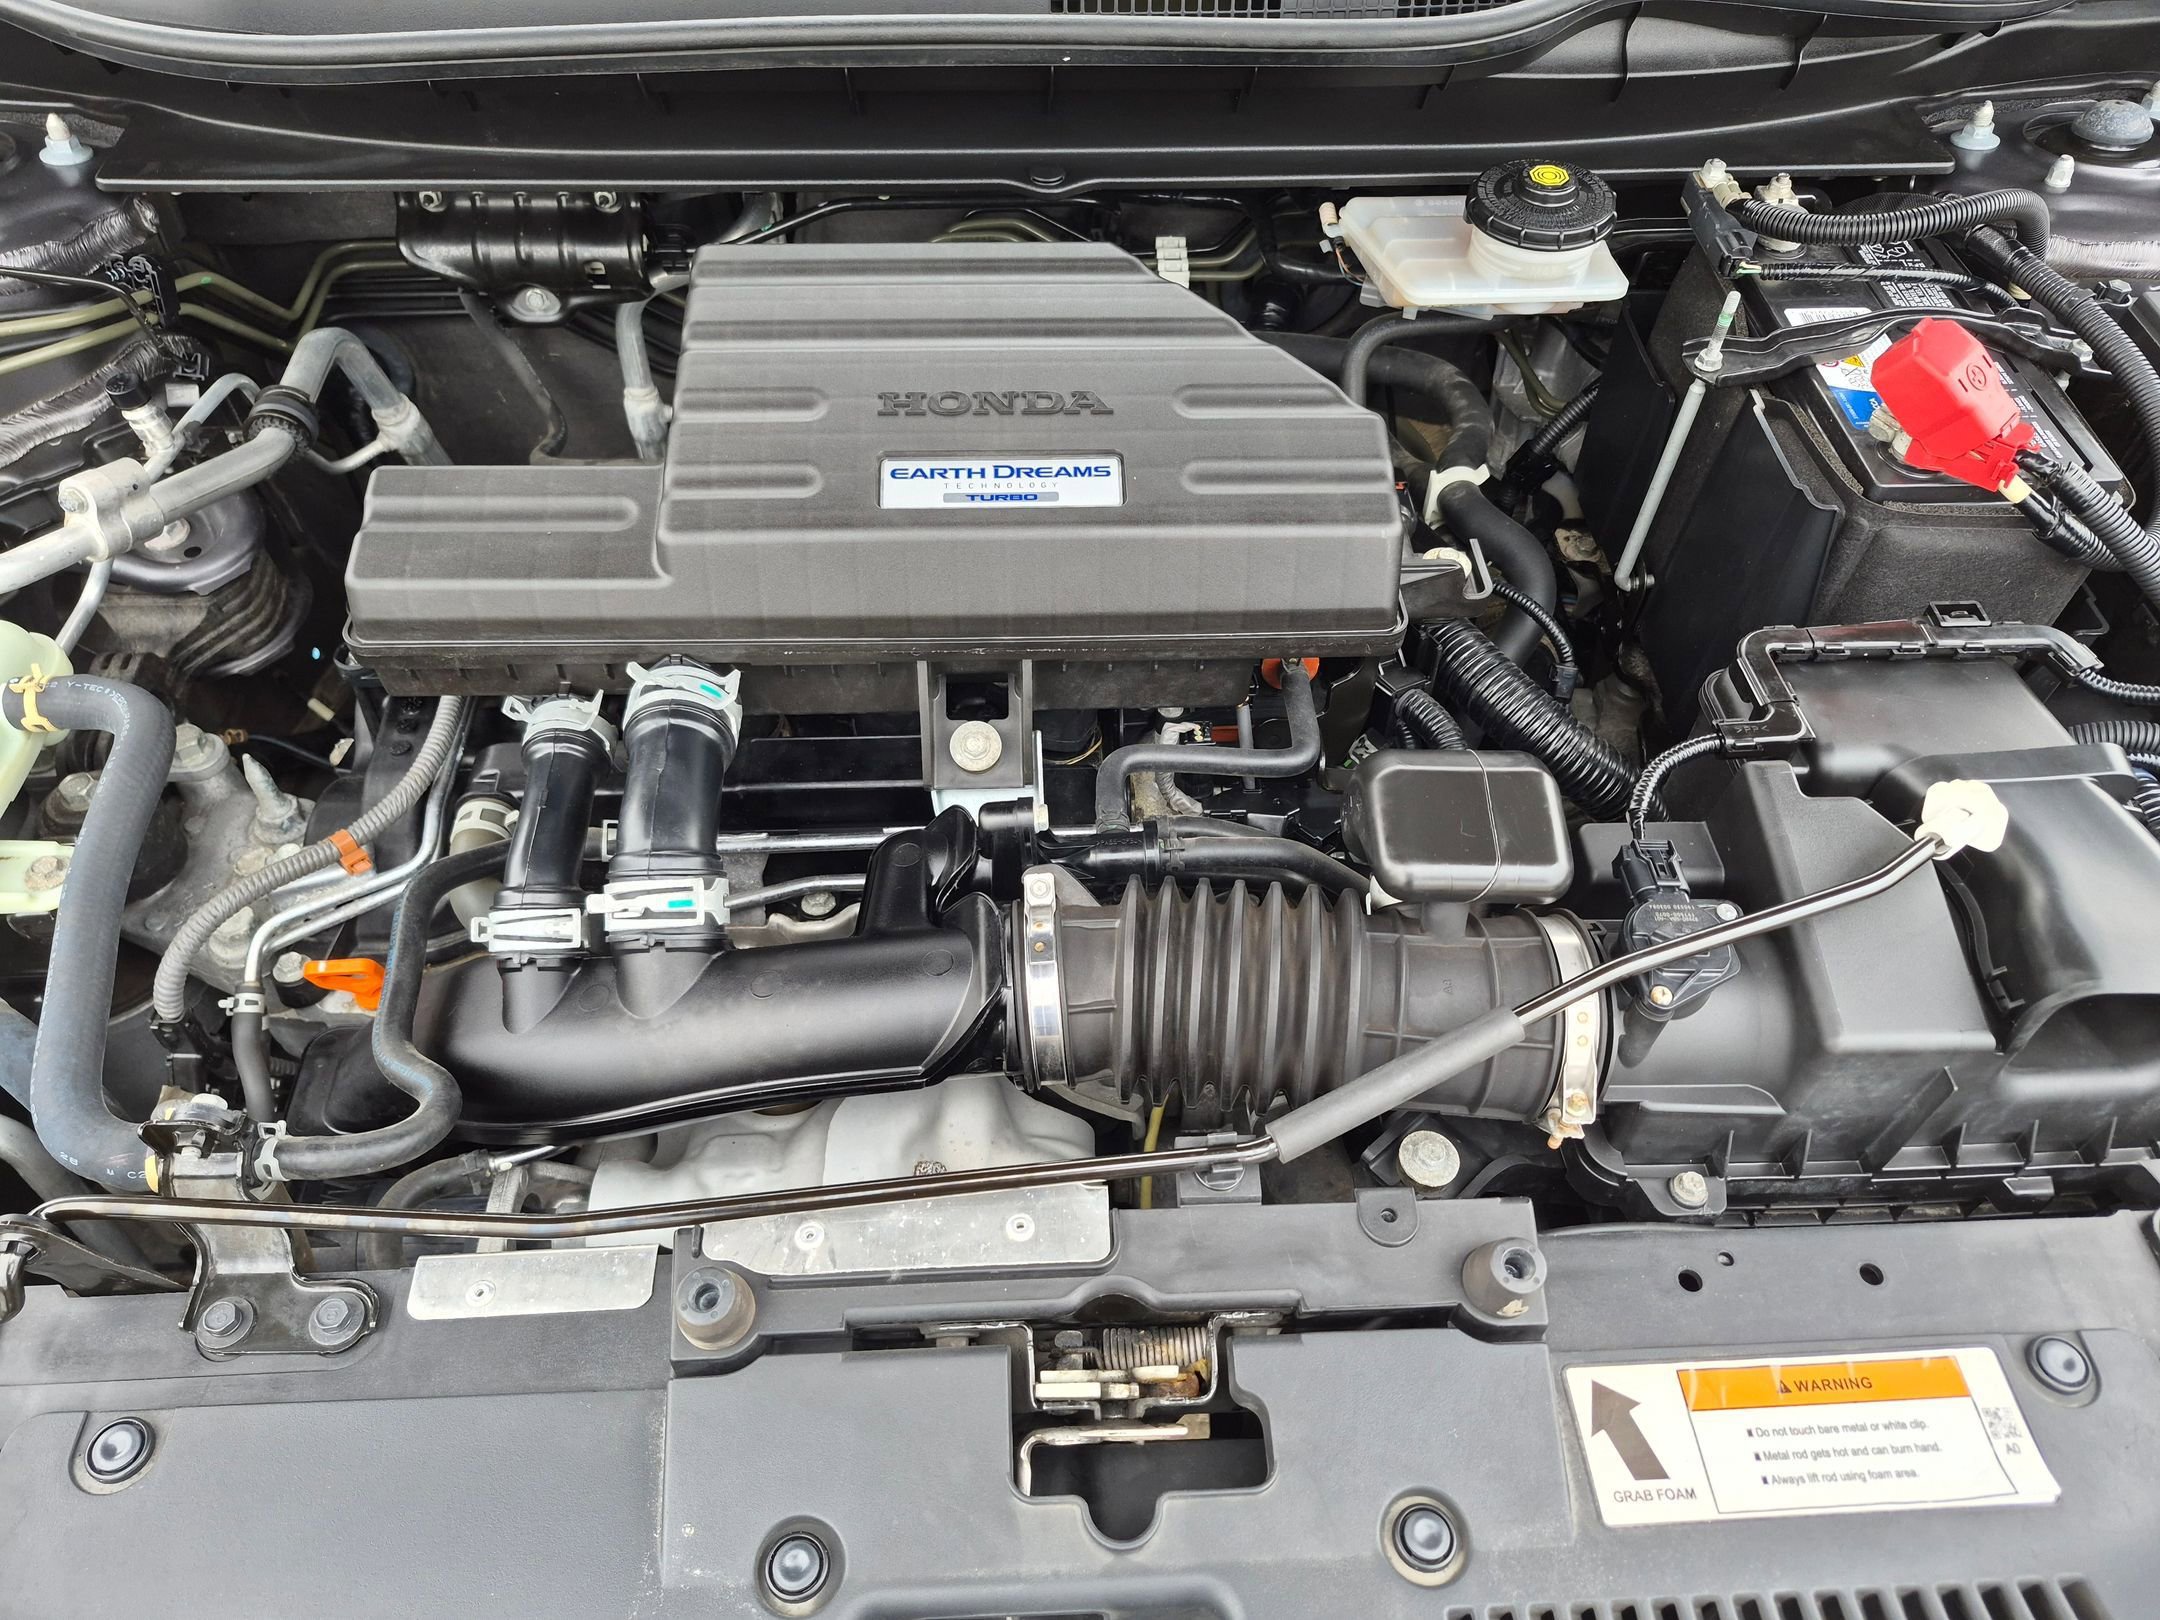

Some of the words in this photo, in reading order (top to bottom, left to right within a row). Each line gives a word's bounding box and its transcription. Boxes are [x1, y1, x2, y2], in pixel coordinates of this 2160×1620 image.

[877, 390, 1115, 416] HONDA
[890, 466, 987, 480] EARTH
[992, 464, 1112, 479] DREAMS
[943, 481, 1059, 490] TECHNOLOGY
[965, 493, 1039, 502] TURBO
[1793, 1376, 1873, 1393] WARNING
[1755, 1426, 1771, 1438] Do
[1772, 1426, 1787, 1437] not
[1789, 1424, 1816, 1436] touch
[1818, 1423, 1840, 1435] bare
[1841, 1421, 1868, 1433] metal
[1870, 1422, 1880, 1432] or
[1881, 1419, 1908, 1431] white
[1909, 1418, 1929, 1431] clip.
[1762, 1449, 1790, 1462] Metal
[1792, 1448, 1809, 1460] rod
[1810, 1448, 1831, 1461] gets
[1832, 1446, 1849, 1458] hot
[1850, 1445, 1869, 1457] and
[1871, 1445, 1889, 1456] can
[1890, 1443, 1913, 1455] burn
[1913, 1440, 1943, 1453] hand.
[1771, 1474, 1806, 1486] Always
[1806, 1472, 1821, 1483] lift
[1821, 1471, 1838, 1482] rod
[1839, 1469, 1867, 1483] using
[1867, 1468, 1893, 1480] foam
[1894, 1467, 1920, 1479] area.
[1613, 1489, 1654, 1503] GRAB
[1656, 1487, 1697, 1501] FOAM
